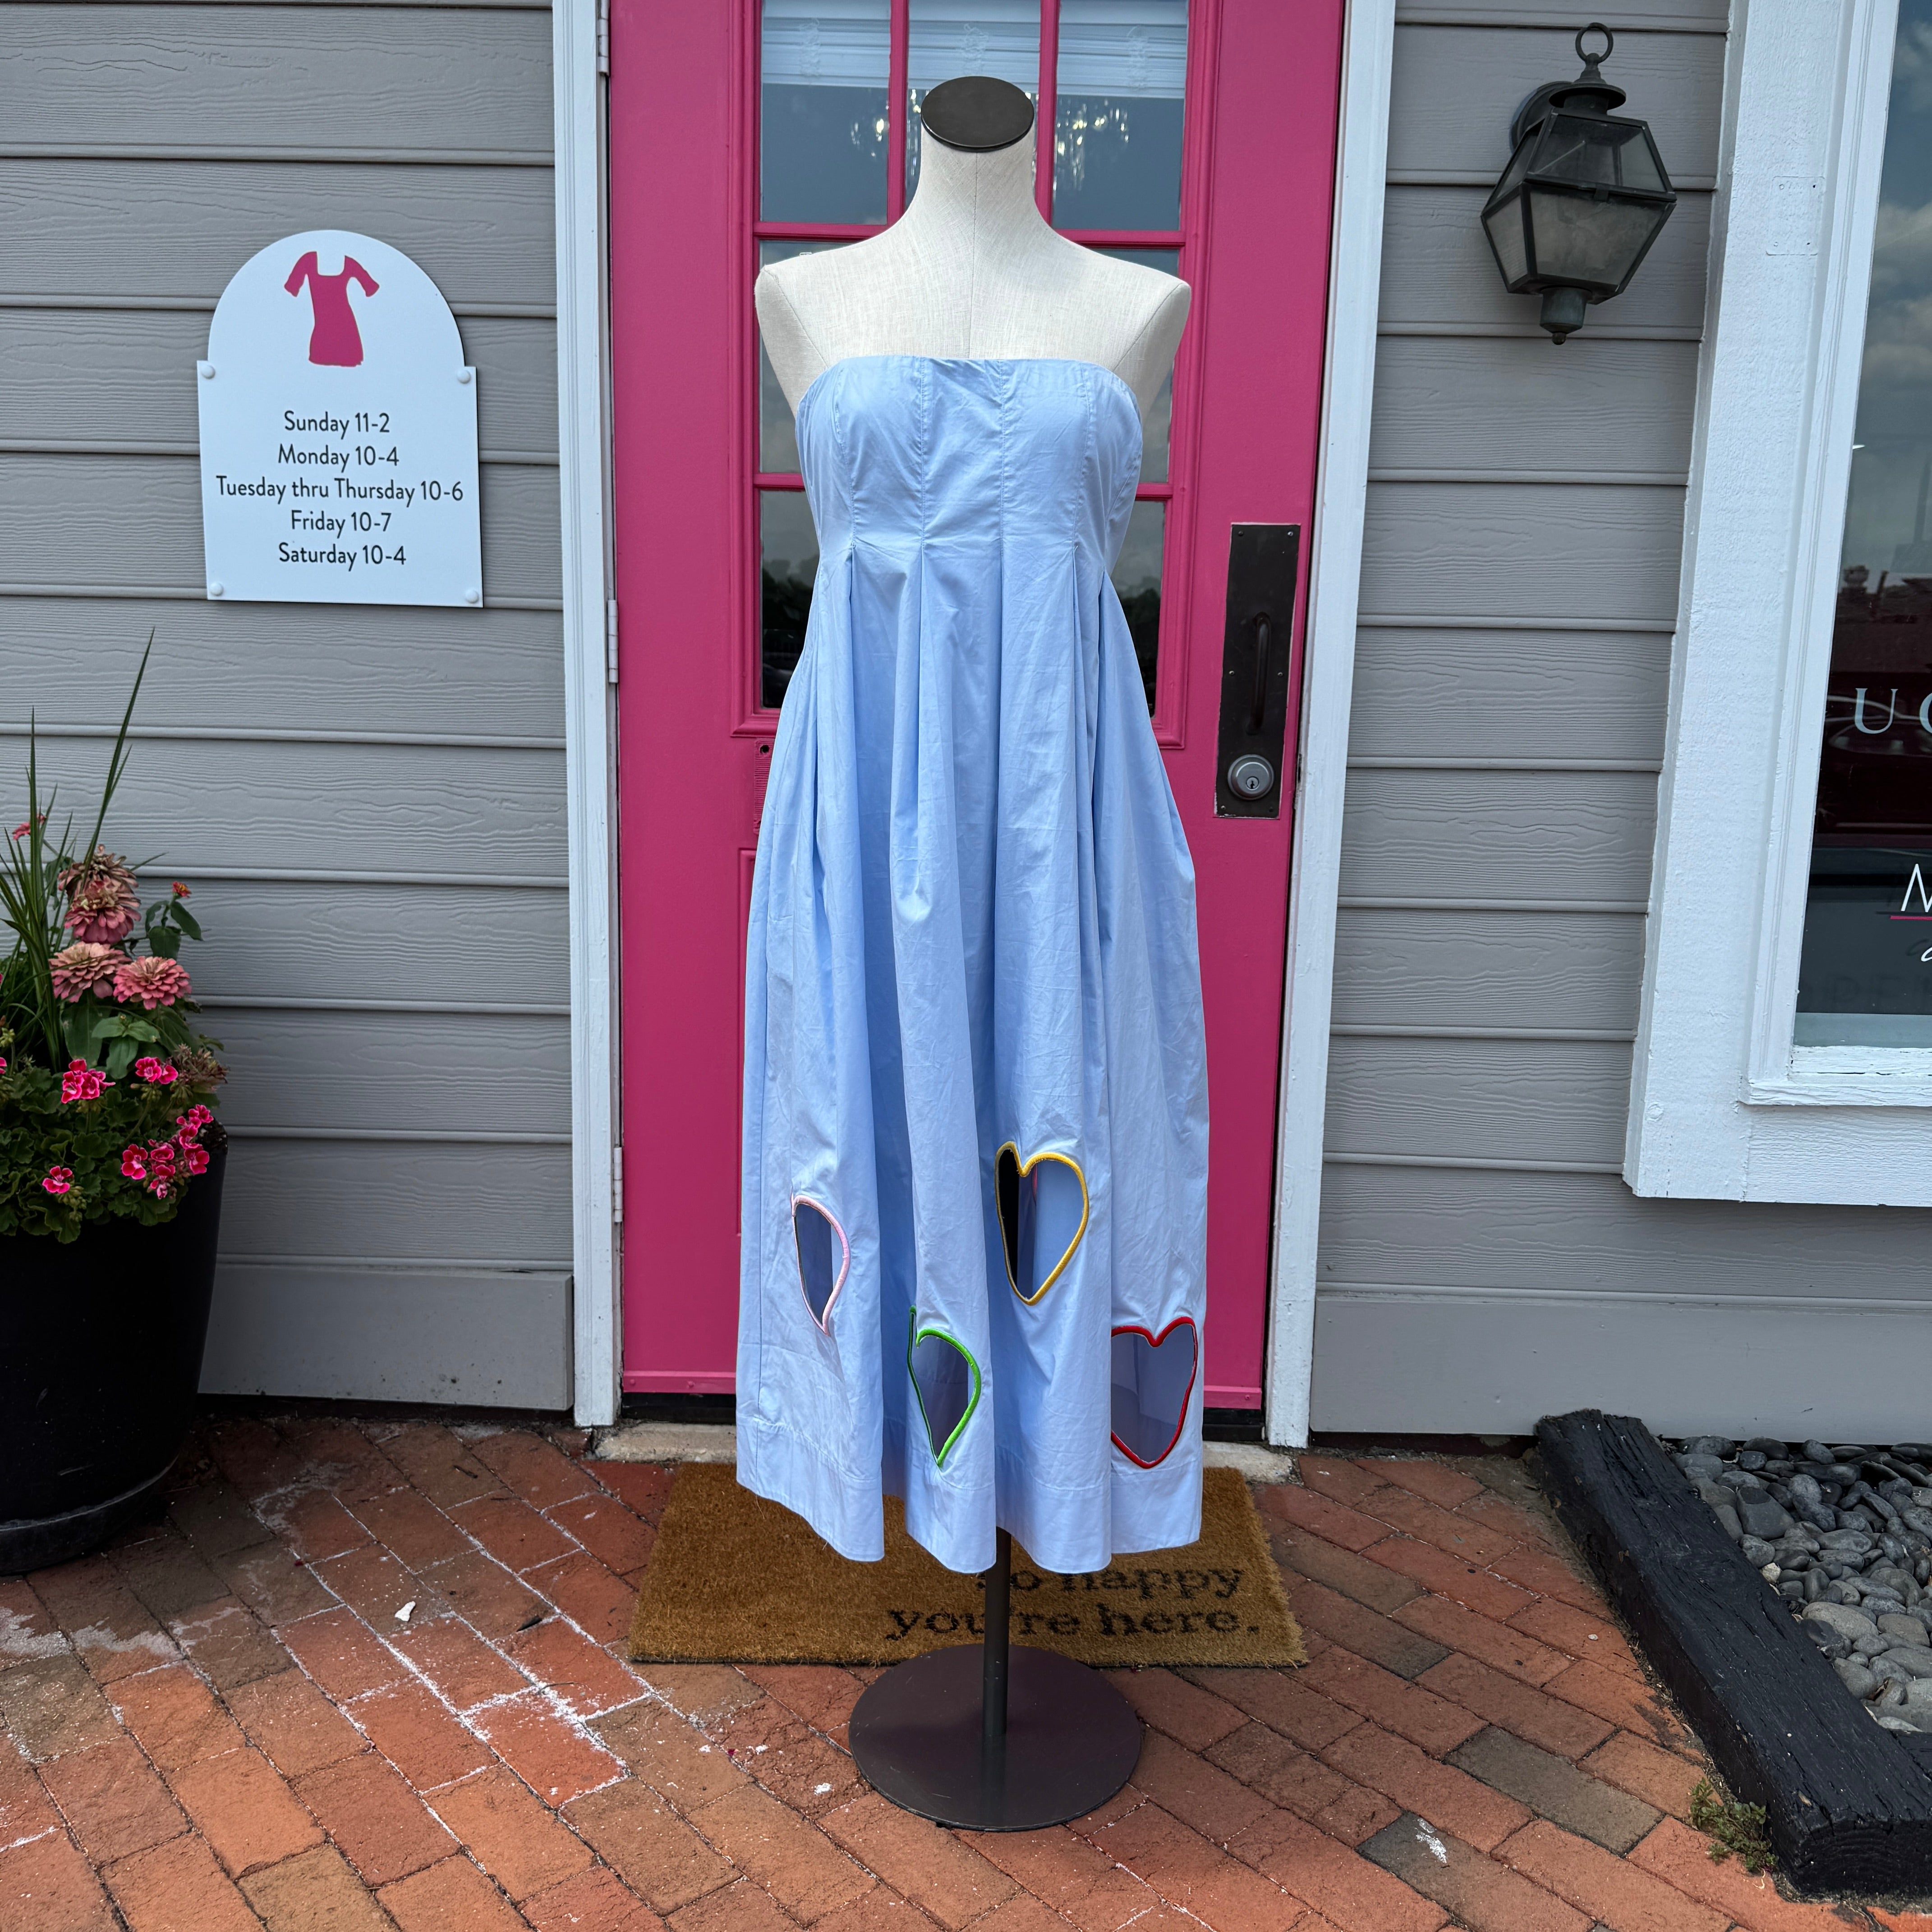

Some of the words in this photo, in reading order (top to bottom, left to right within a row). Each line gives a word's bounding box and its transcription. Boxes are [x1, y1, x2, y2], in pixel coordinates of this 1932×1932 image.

[284, 410, 350, 440] Sunday
[355, 412, 390, 433] 11-2
[278, 443, 350, 473] Monday
[355, 446, 400, 466] 10-4
[216, 475, 286, 505] Tuesday
[292, 477, 329, 498] thru
[334, 478, 415, 508] Thursday
[421, 480, 463, 501] 10-6
[291, 510, 346, 539] Friday
[351, 511, 391, 532] 10-7
[279, 542, 357, 572] Saturday
[362, 545, 406, 565] 10-4
[1096, 1603, 1260, 1635] here.
